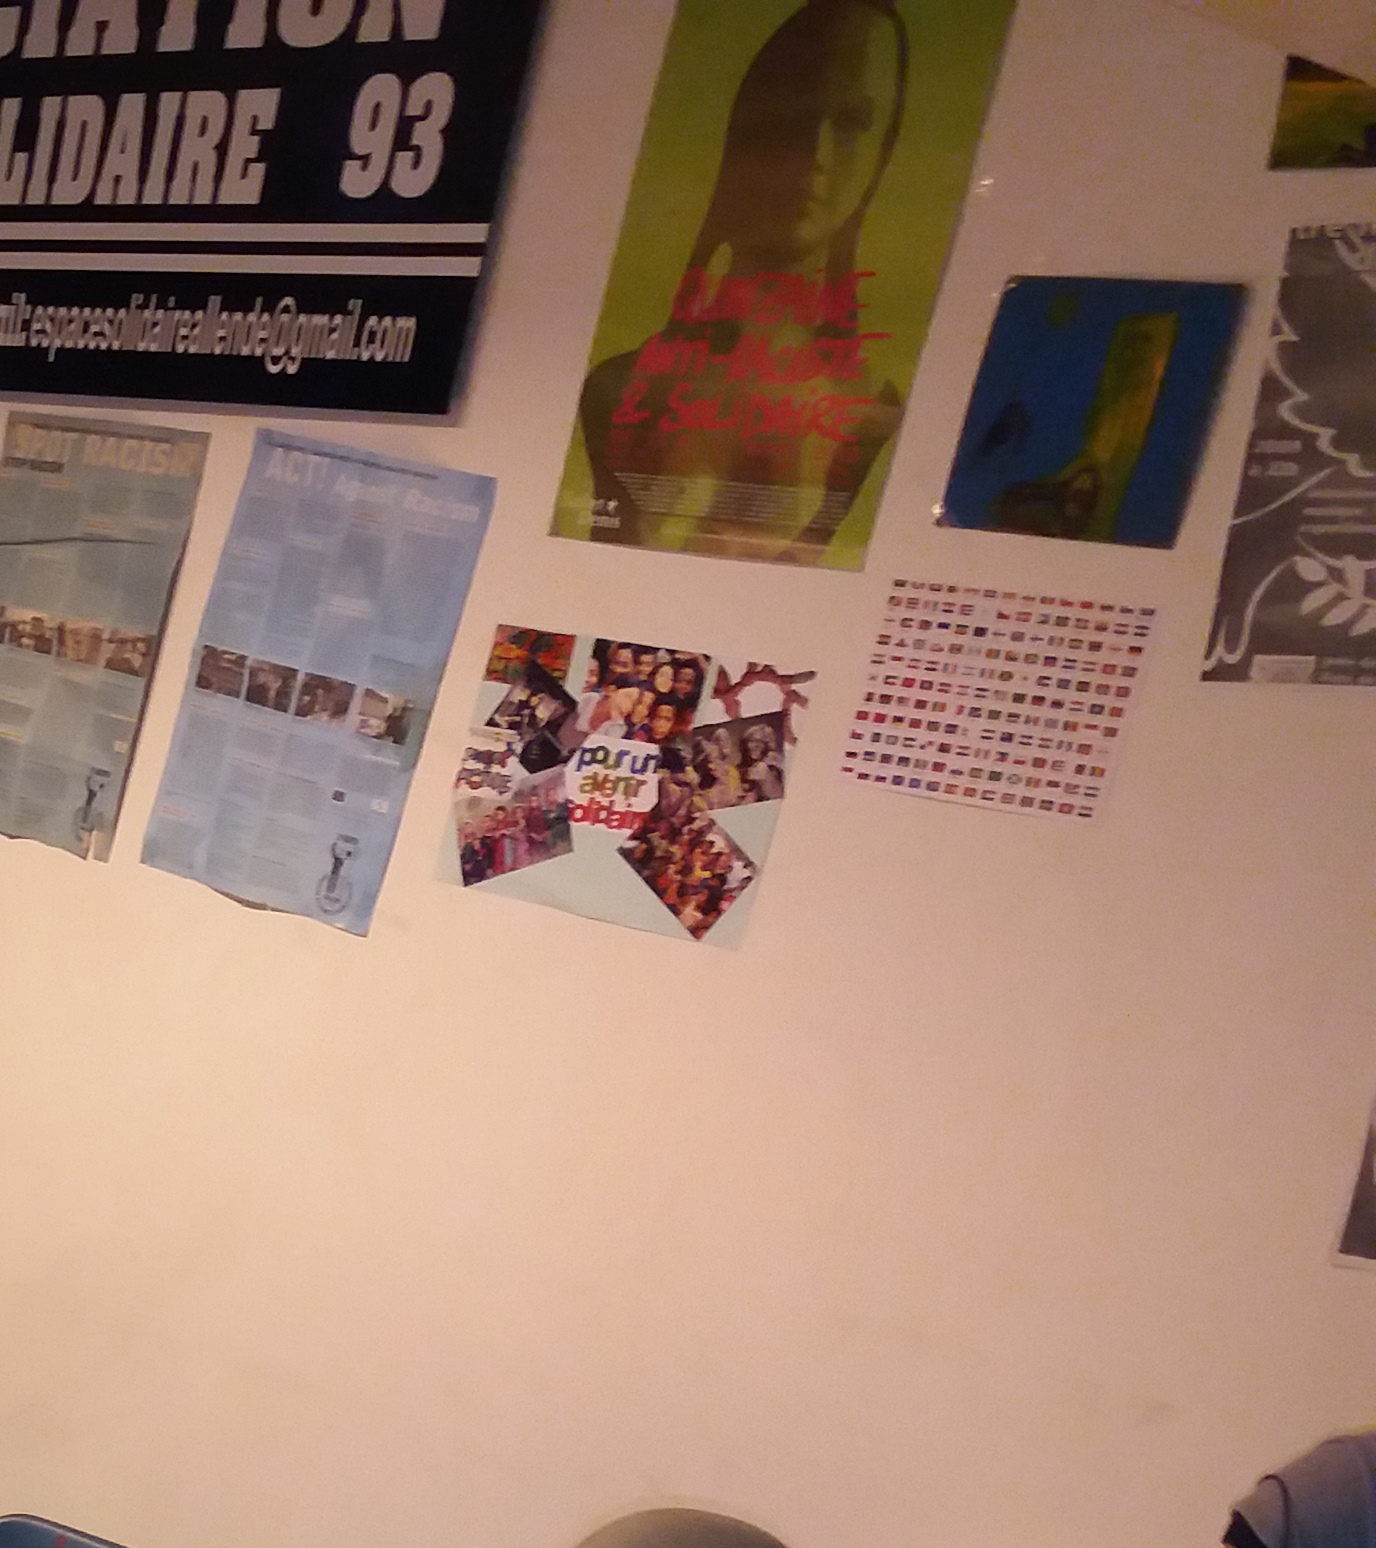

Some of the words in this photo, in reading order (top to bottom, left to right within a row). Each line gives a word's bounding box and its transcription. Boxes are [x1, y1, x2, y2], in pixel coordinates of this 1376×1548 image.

[338, 73, 456, 201] 93
[611, 382, 650, 424] &
[659, 382, 876, 443] SOLIDAIRE
[574, 745, 630, 772] pour
